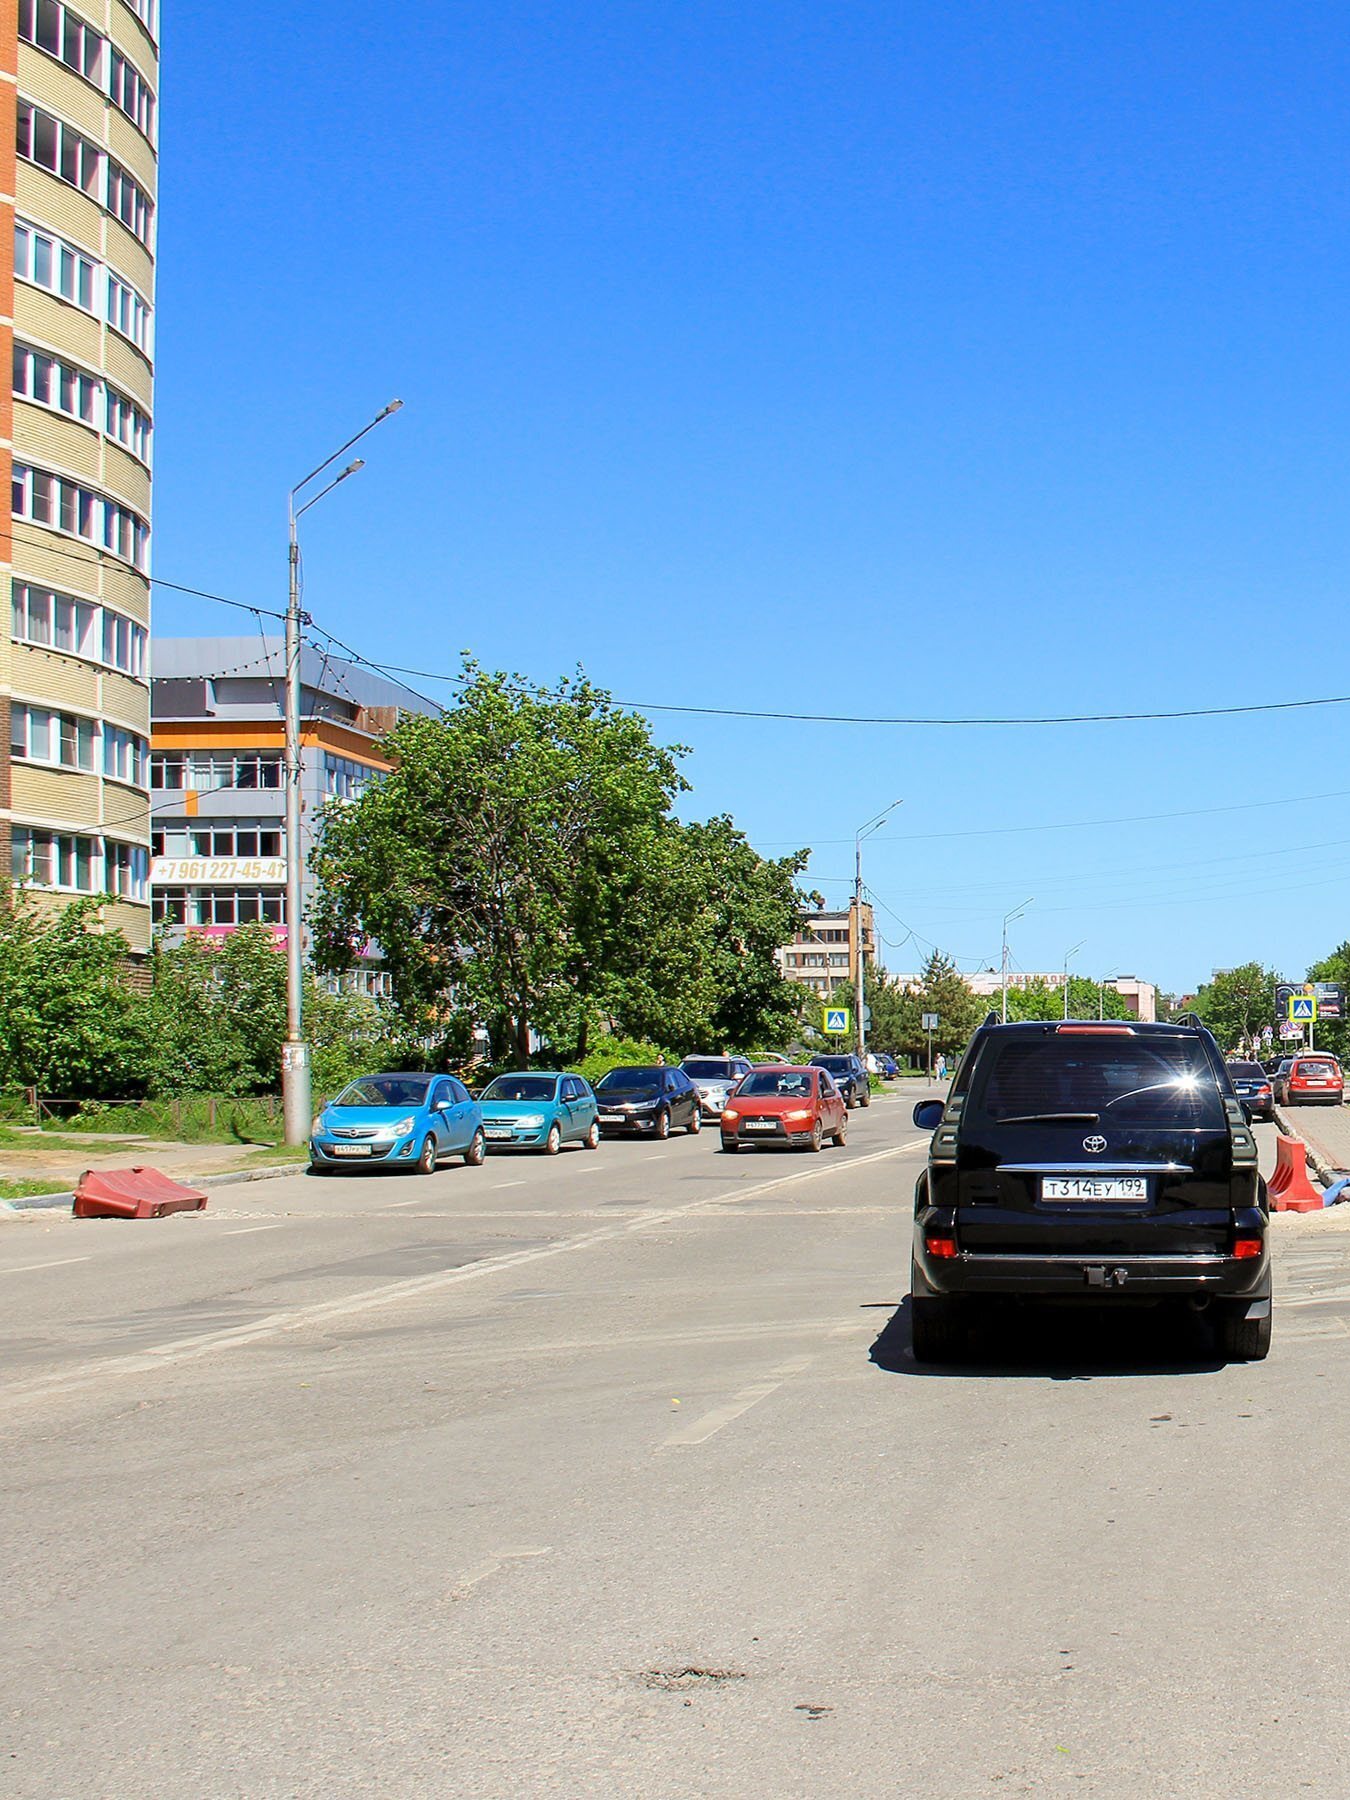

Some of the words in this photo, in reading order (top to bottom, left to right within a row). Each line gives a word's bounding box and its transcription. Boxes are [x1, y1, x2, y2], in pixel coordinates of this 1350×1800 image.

[158, 862, 177, 878] +7
[178, 861, 207, 879] 961
[209, 861, 285, 879] 227-45-41
[1118, 1179, 1142, 1192] 199
